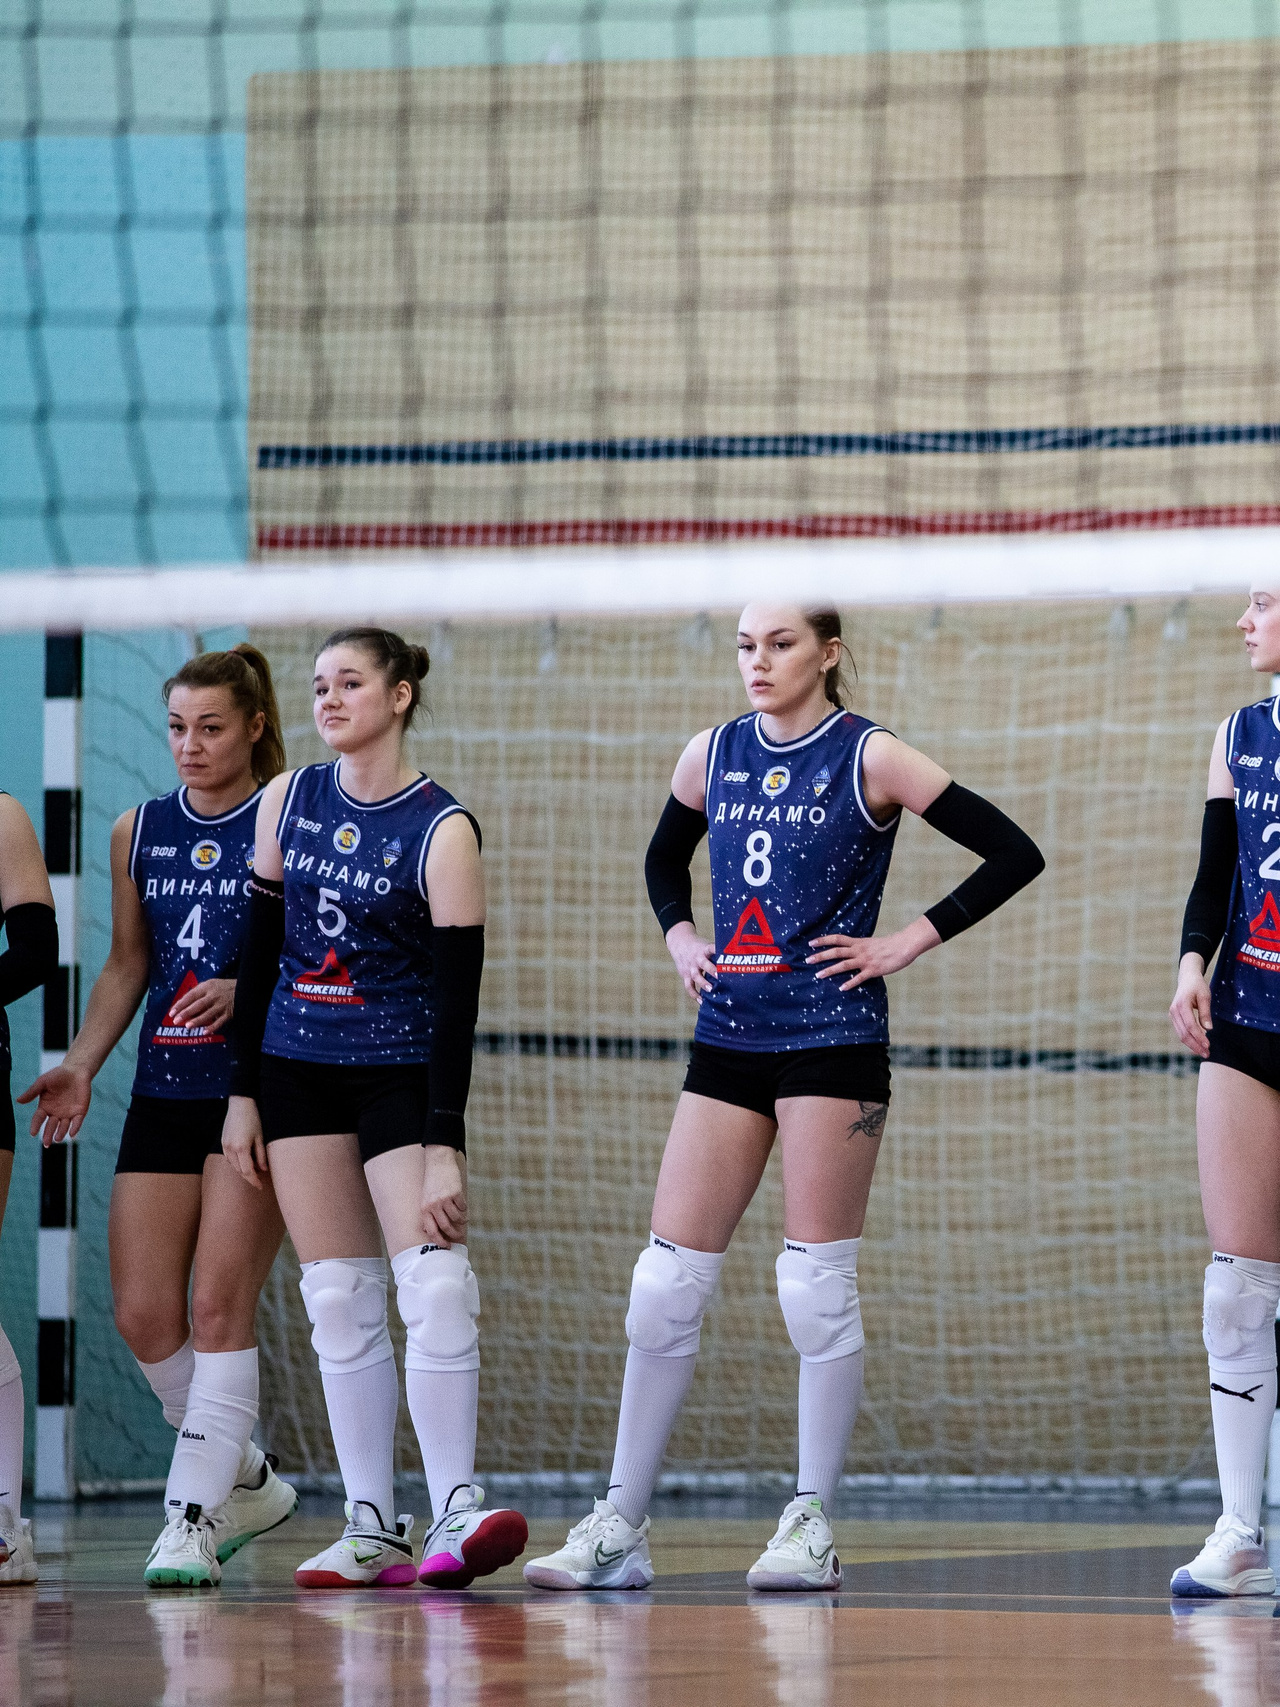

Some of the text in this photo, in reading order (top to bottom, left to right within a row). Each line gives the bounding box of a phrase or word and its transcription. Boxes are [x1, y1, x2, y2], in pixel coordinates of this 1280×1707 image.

[1237, 754, 1263, 768] ВФВ
[723, 771, 751, 783] ВФВ
[714, 801, 826, 825] ДИНАМО
[296, 817, 323, 834] ВФВ
[151, 846, 178, 857] ВФВ
[743, 829, 772, 887] 8
[283, 849, 392, 896] ДИНАМО
[145, 878, 252, 900] ДИНАМО
[317, 887, 347, 938] 5
[176, 903, 205, 960] 4
[716, 954, 783, 965] ДВИЖЕНИЕ
[156, 1026, 205, 1037] ДВИЖЕН
[1217, 1255, 1235, 1264] asics
